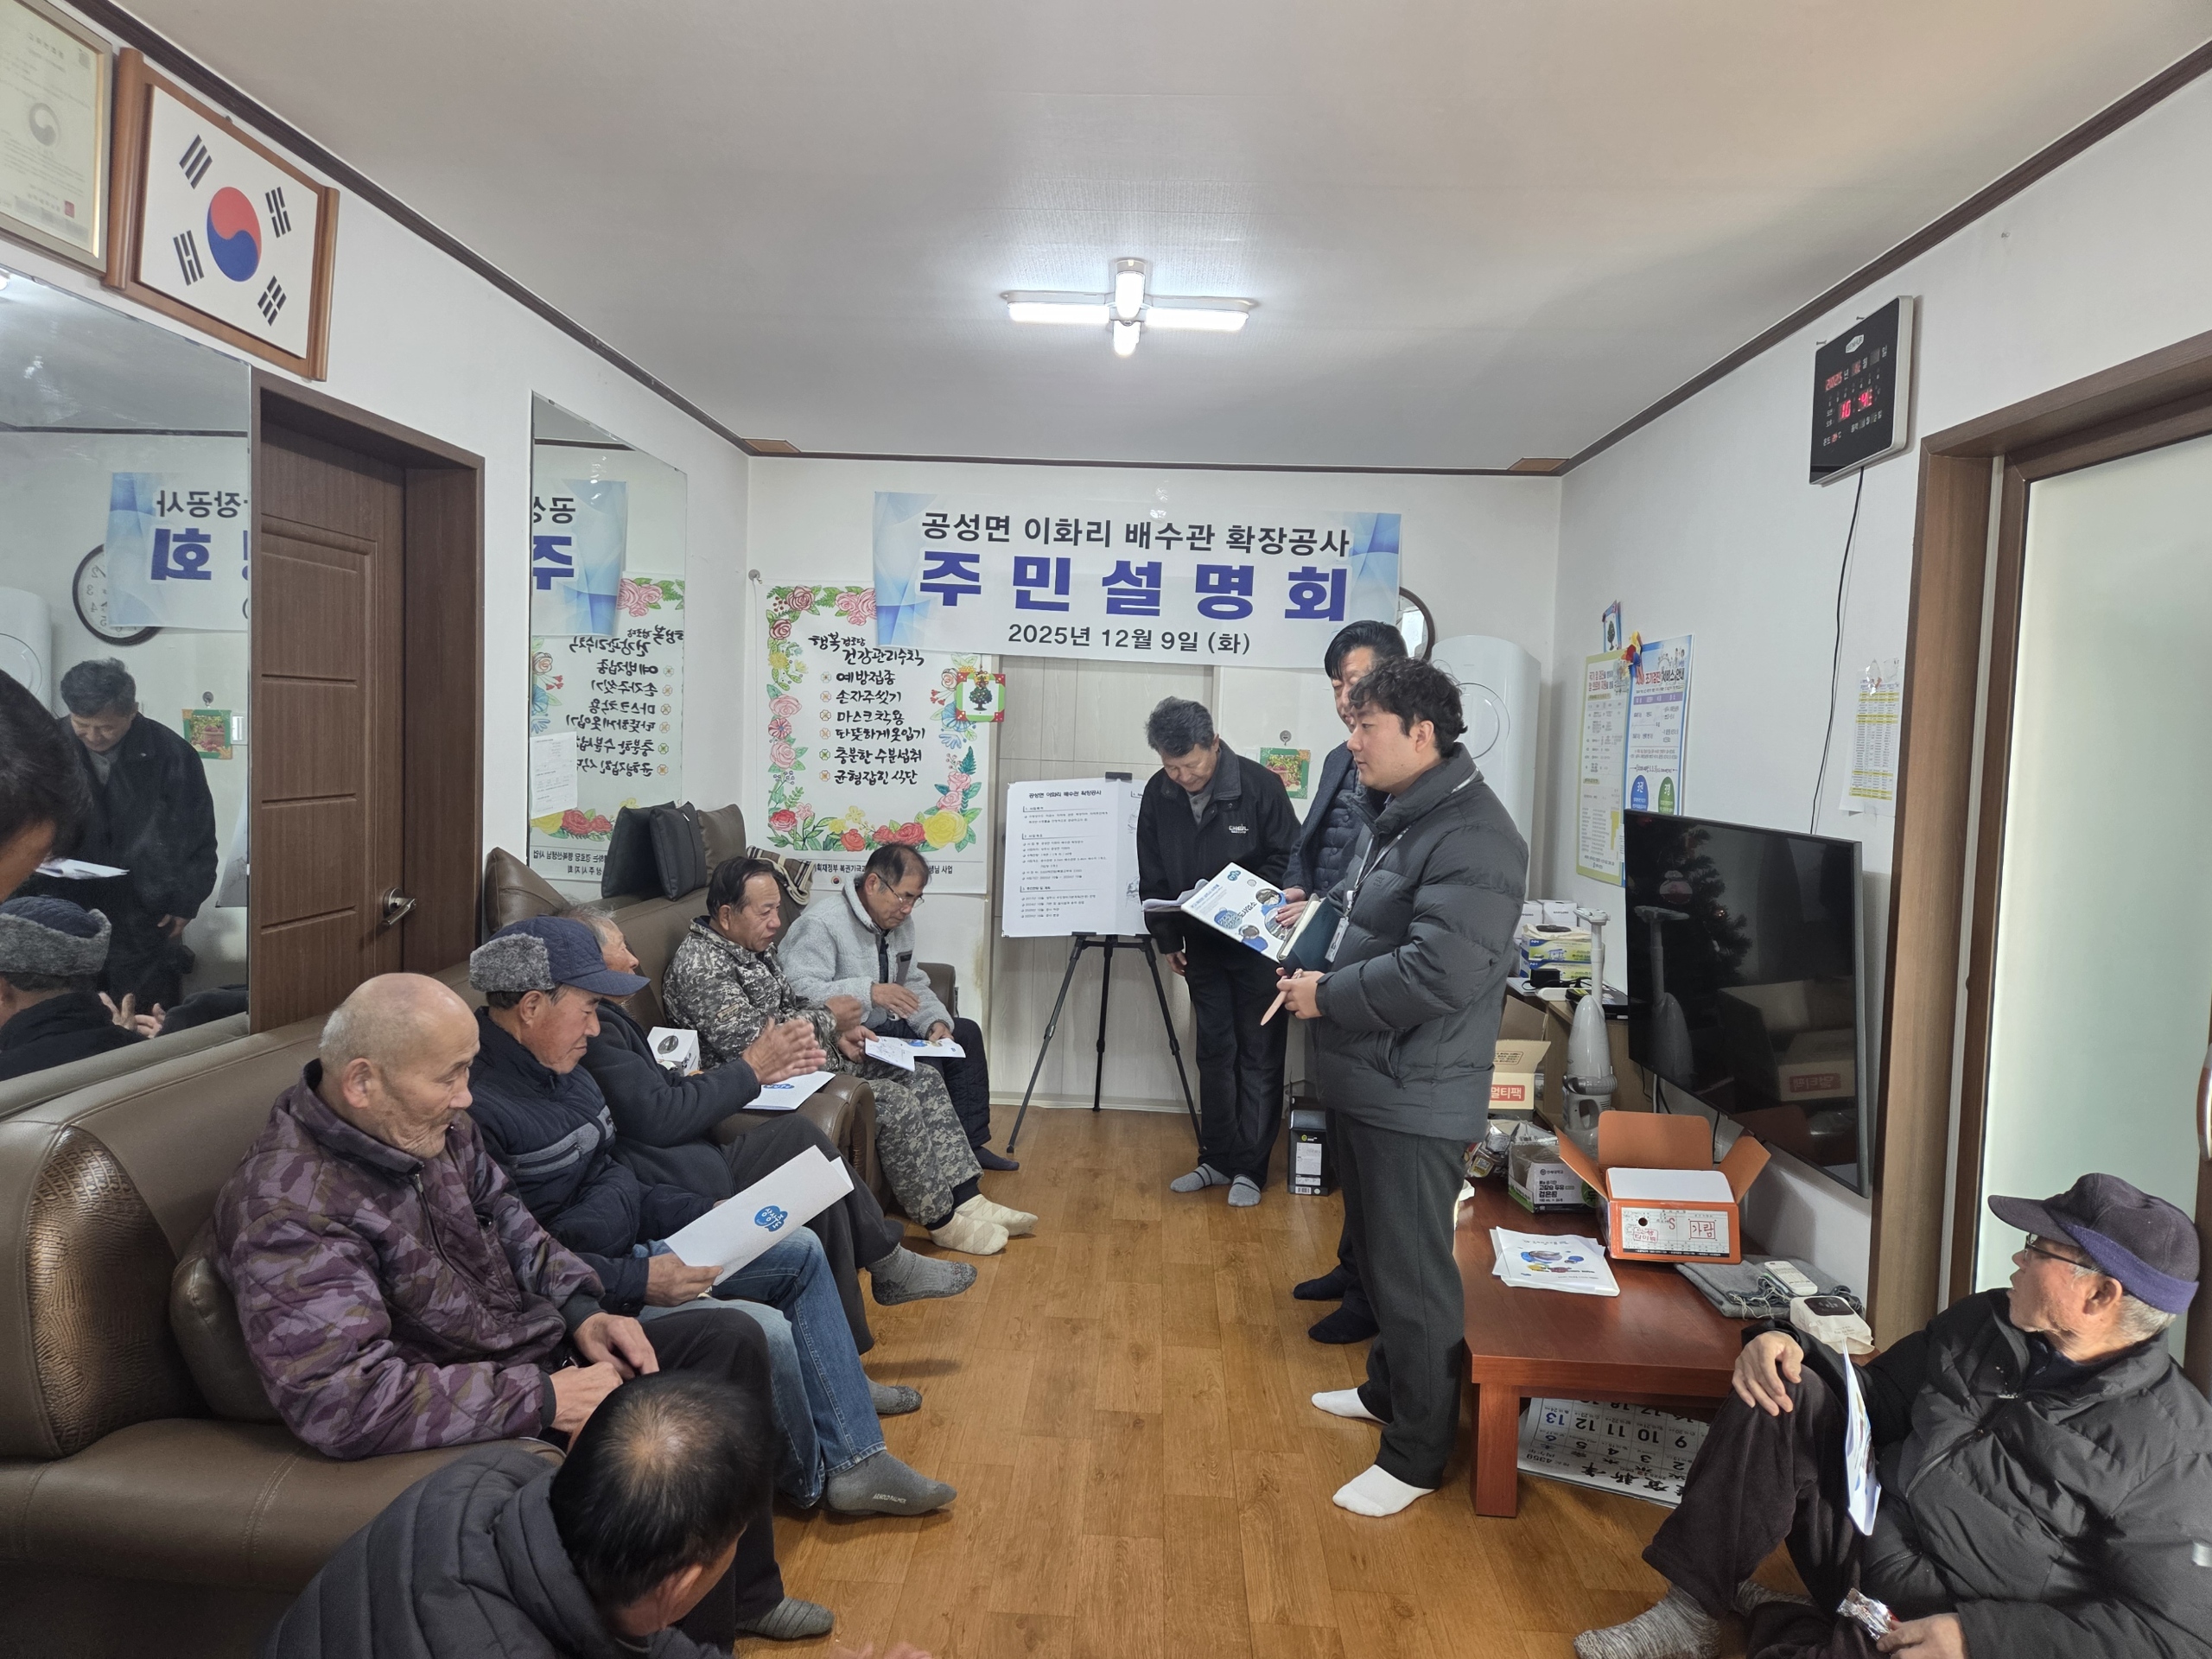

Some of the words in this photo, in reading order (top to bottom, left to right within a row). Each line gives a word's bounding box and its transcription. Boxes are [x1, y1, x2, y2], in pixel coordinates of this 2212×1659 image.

[921, 512, 1011, 543] 공성면
[1026, 517, 1110, 548] 이화리
[1125, 522, 1214, 552] 배수관
[1226, 524, 1349, 557] 확장공사
[809, 632, 841, 651] 행복
[1009, 624, 1090, 646] 2025년
[1102, 627, 1153, 650] 12월
[1161, 630, 1198, 652] 9일
[1209, 632, 1250, 655] (화)
[842, 648, 925, 665] 건강관리수칙
[836, 671, 895, 685] 예방접종
[836, 690, 901, 703] 손자주씻기
[837, 709, 904, 726] 마스크착용
[834, 748, 872, 765] 충분한
[874, 748, 922, 764] 수분섭취
[834, 770, 888, 786] 균형잡힌
[891, 770, 918, 785] 식단
[815, 864, 838, 873] 획재정부
[1491, 1087, 1522, 1099] 멀티팩
[1546, 1413, 1564, 1425] 13
[1575, 1418, 1595, 1431] 12
[1608, 1424, 1625, 1437] 11
[1638, 1429, 1659, 1443] 10
[1675, 1436, 1687, 1448] 9
[1641, 1454, 1652, 1463] 3
[1673, 1461, 1684, 1470] 2
